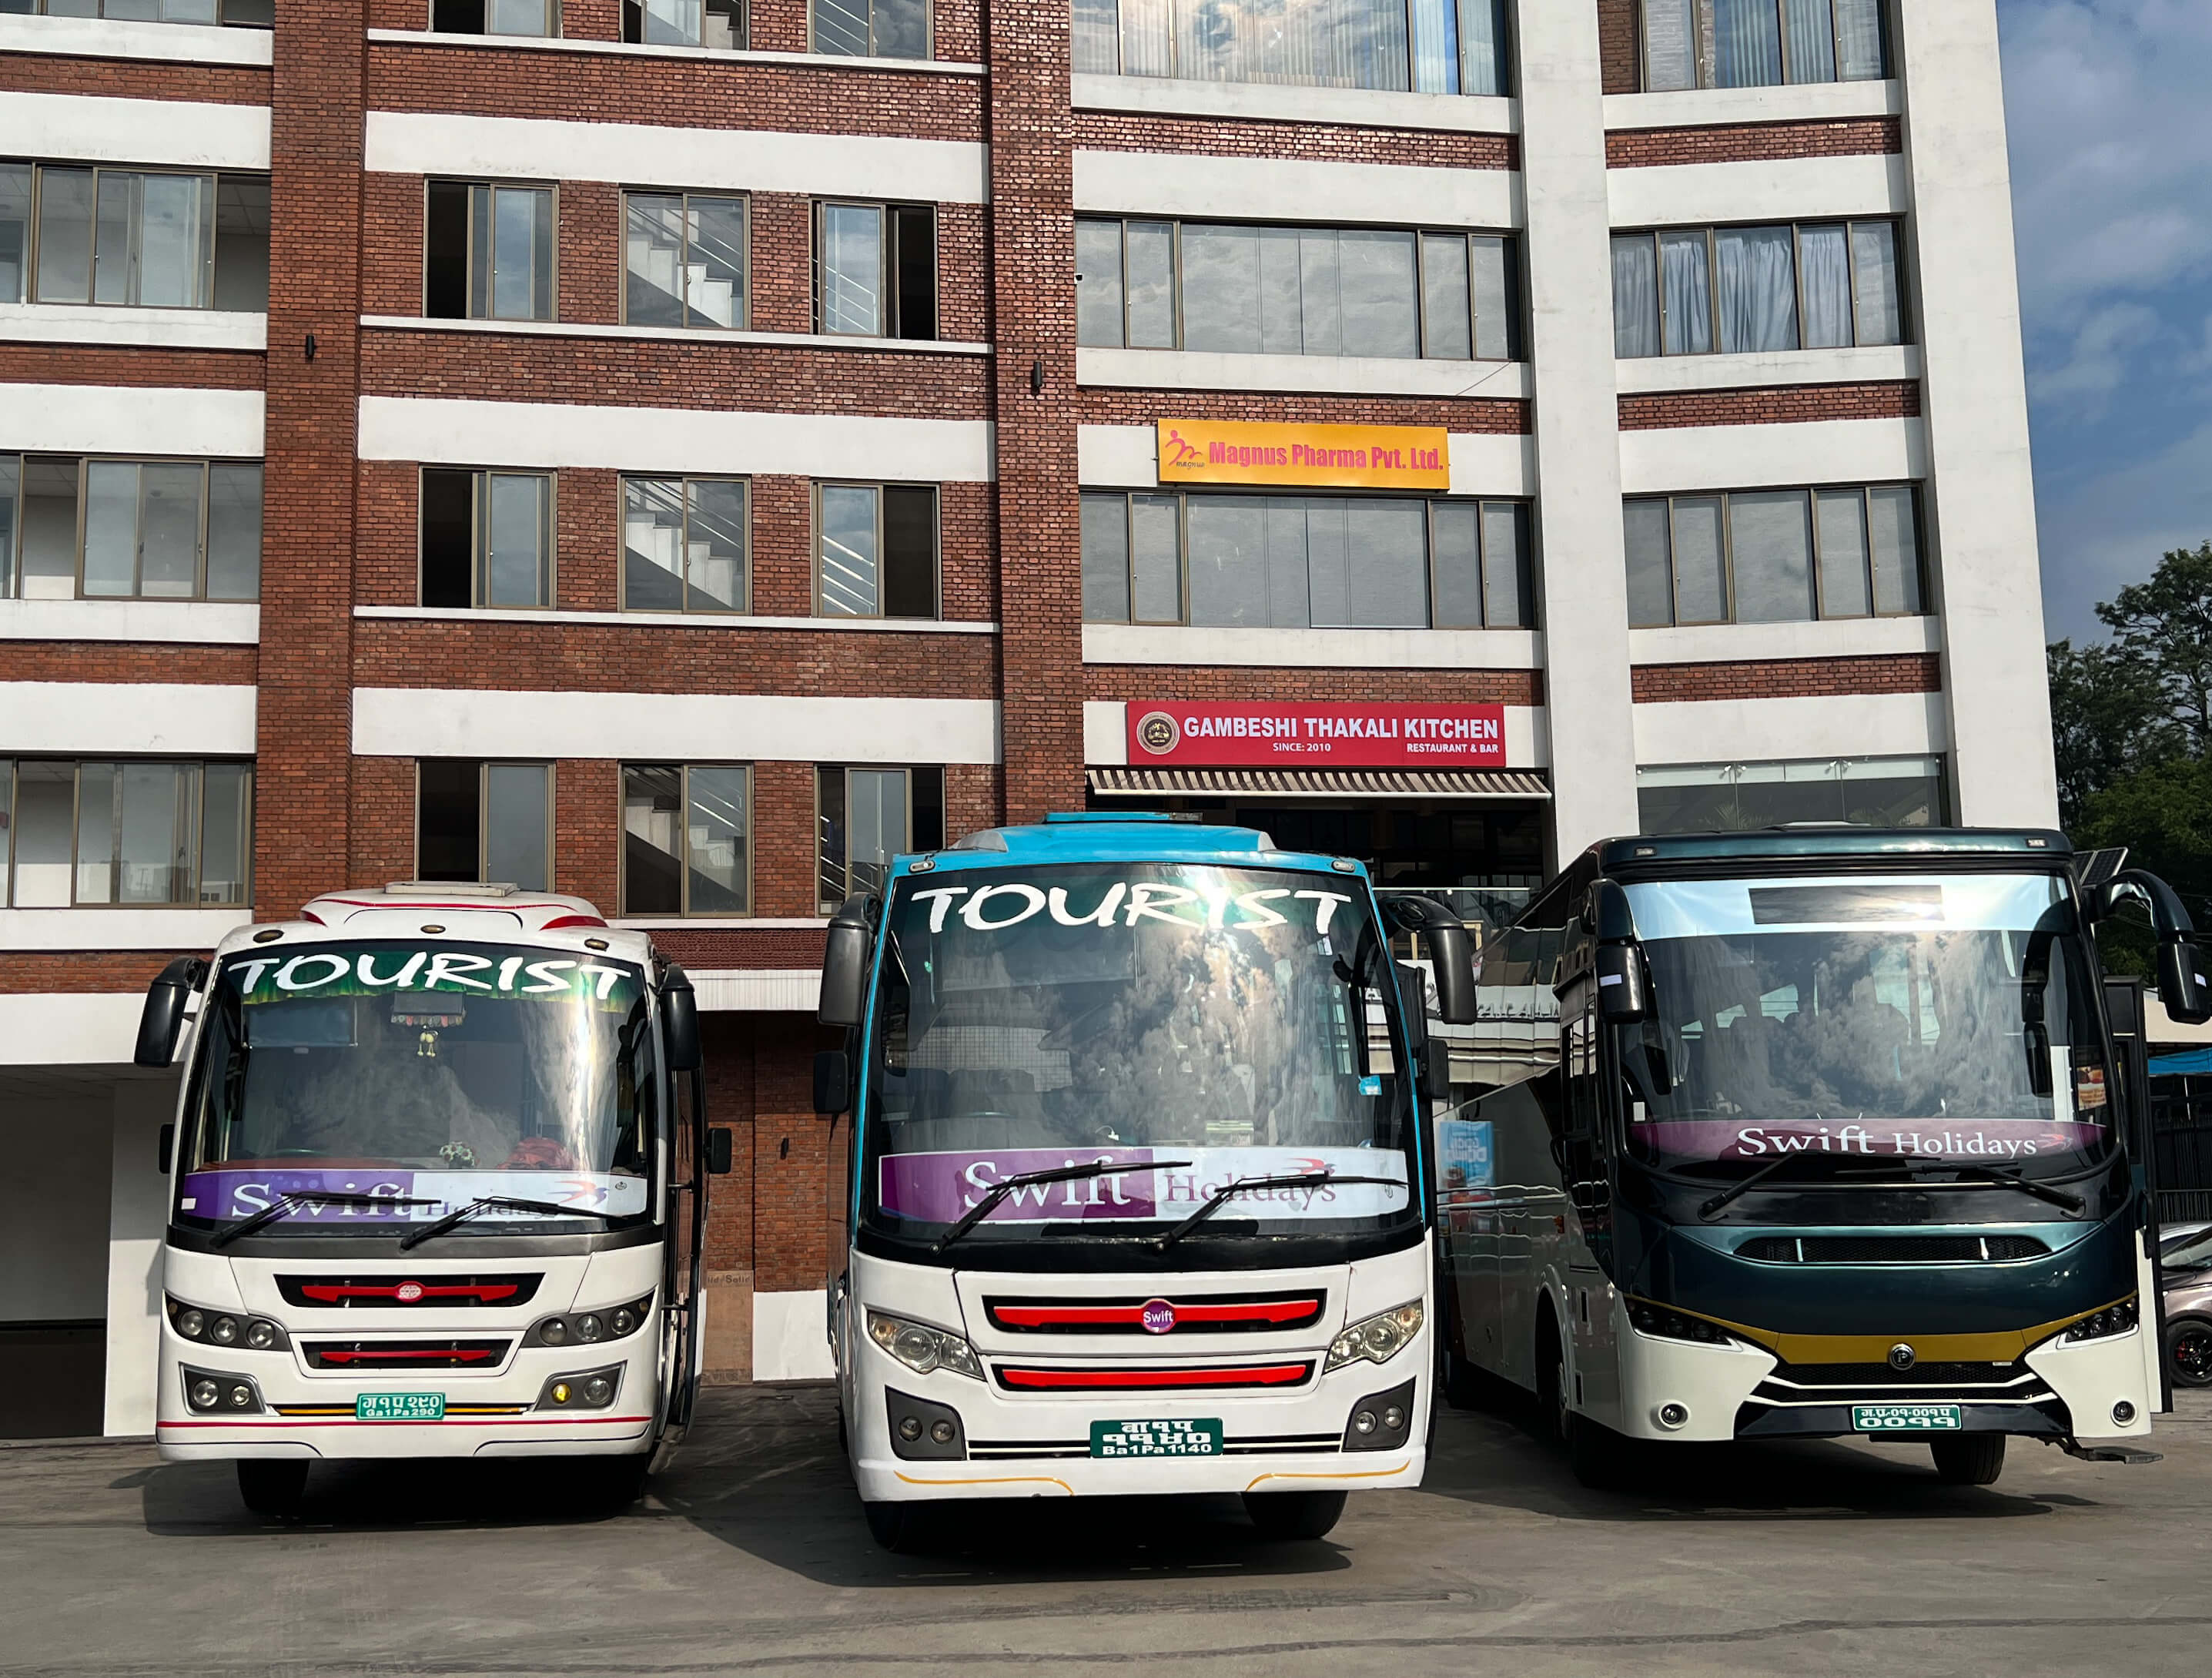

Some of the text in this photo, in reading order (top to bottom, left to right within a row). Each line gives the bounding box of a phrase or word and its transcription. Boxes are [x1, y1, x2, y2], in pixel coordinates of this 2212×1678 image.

[1210, 442, 1444, 470] Magnus Pharma Pvt. Ltd.
[1183, 716, 1297, 738] GAMBESHI
[1303, 718, 1397, 739] THAKALI
[1404, 718, 1498, 739] KITCHEN
[1273, 742, 1331, 752] SINCE: 2010
[1407, 743, 1498, 753] RESTAURANT & BAR
[911, 882, 1351, 935] TOURIST
[228, 952, 631, 1000] TOURIST
[1738, 1125, 2037, 1159] Swift Holidays
[964, 1155, 1131, 1209] Swift
[232, 1183, 413, 1217] Swift
[1143, 1310, 1173, 1323] Swift
